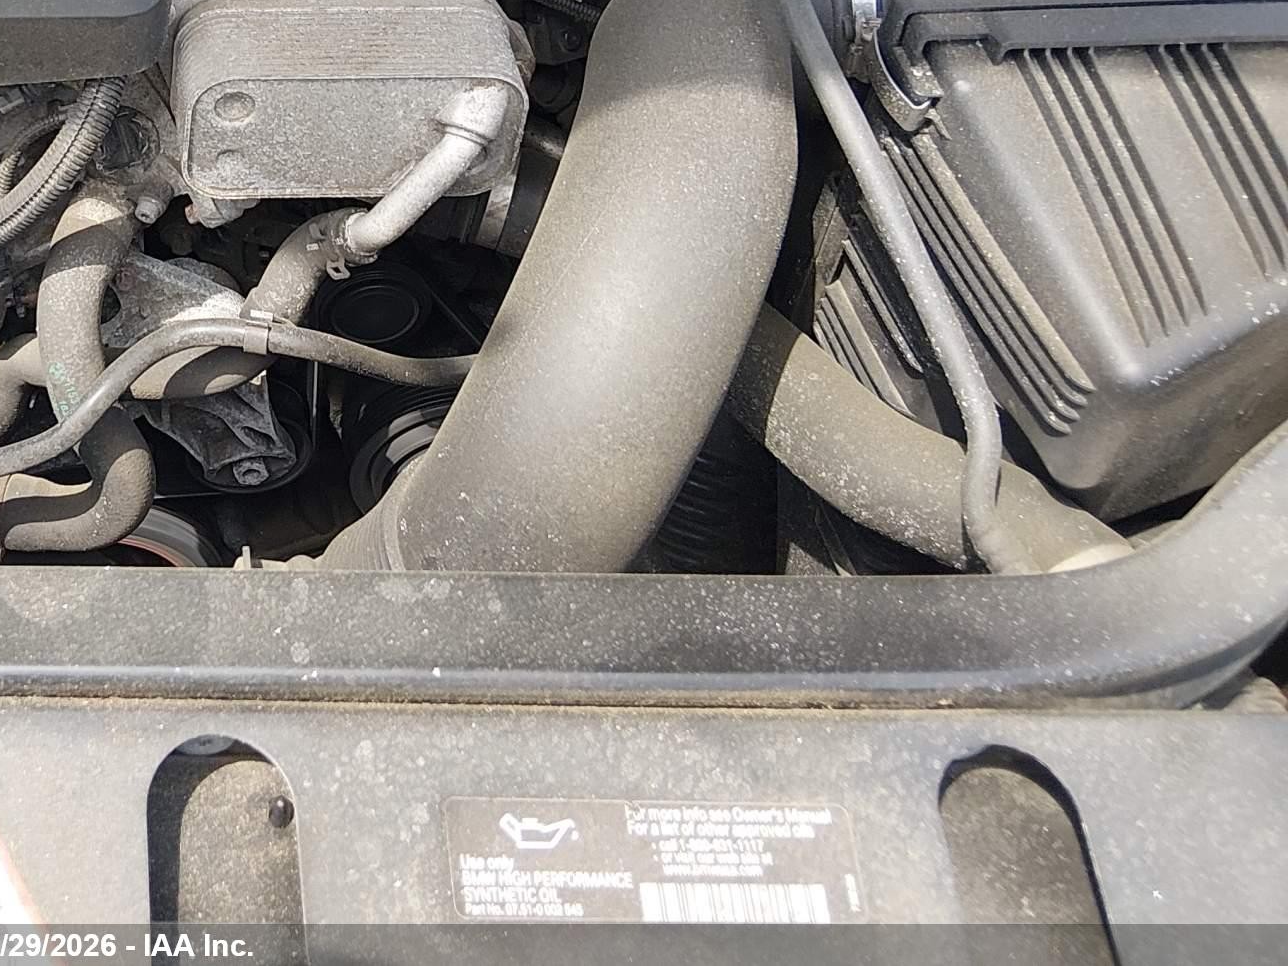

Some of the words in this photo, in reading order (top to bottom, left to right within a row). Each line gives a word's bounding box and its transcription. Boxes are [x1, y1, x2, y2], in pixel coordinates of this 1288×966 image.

[648, 808, 681, 822] more
[627, 821, 648, 836] For
[460, 853, 485, 870] Use
[487, 854, 515, 872] only
[462, 870, 497, 886] BMW
[498, 871, 531, 887] HIGH
[533, 871, 634, 889] PERFORMANCE
[464, 886, 538, 903] SYNTHETIC
[539, 887, 562, 904] OIL
